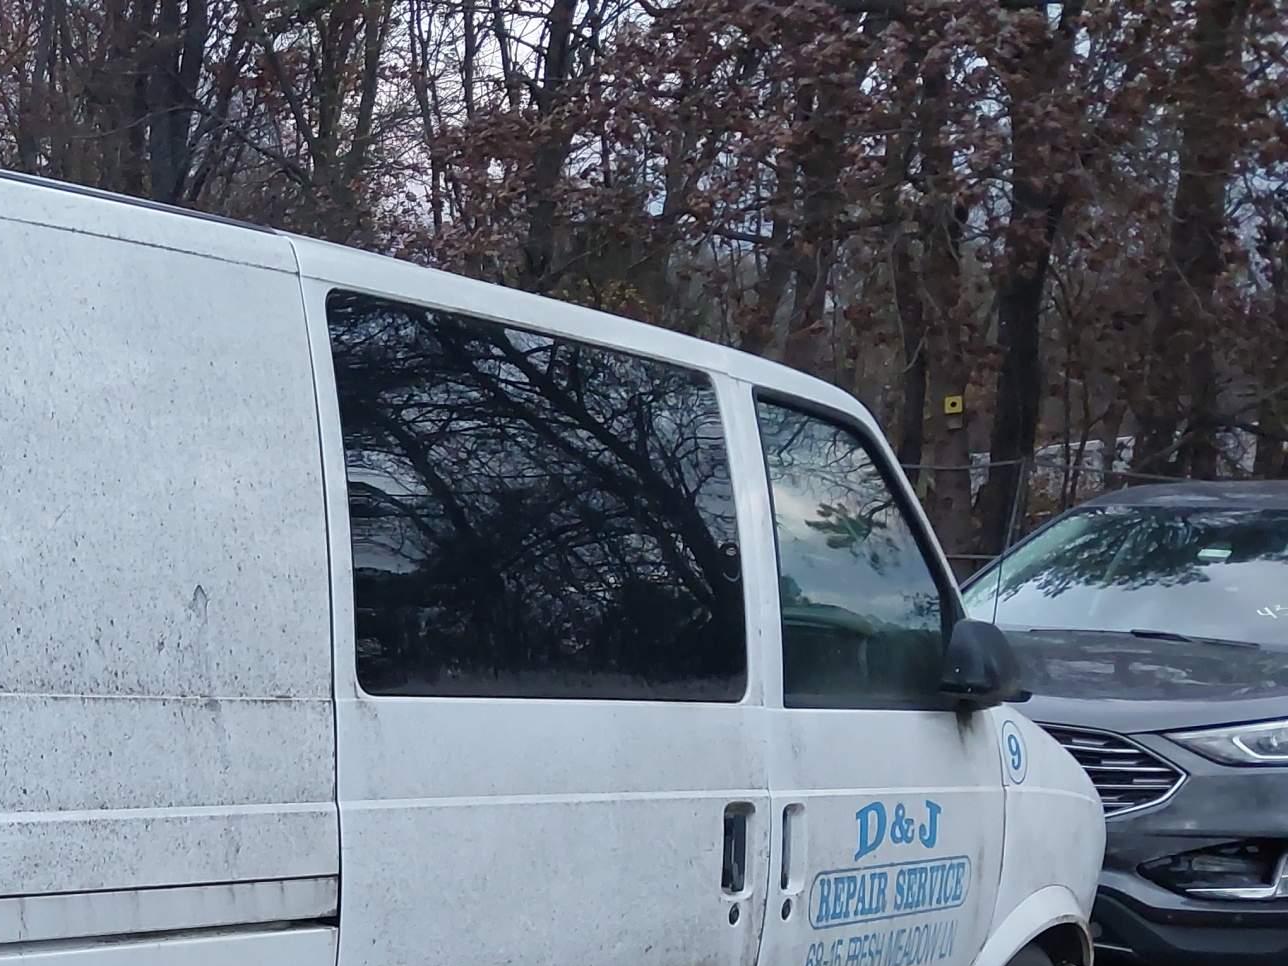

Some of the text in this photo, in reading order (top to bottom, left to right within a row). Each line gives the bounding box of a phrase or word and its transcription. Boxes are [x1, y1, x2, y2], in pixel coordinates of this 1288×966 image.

[1008, 734, 1022, 770] 9
[816, 862, 966, 923] REPAIR SERVICE
